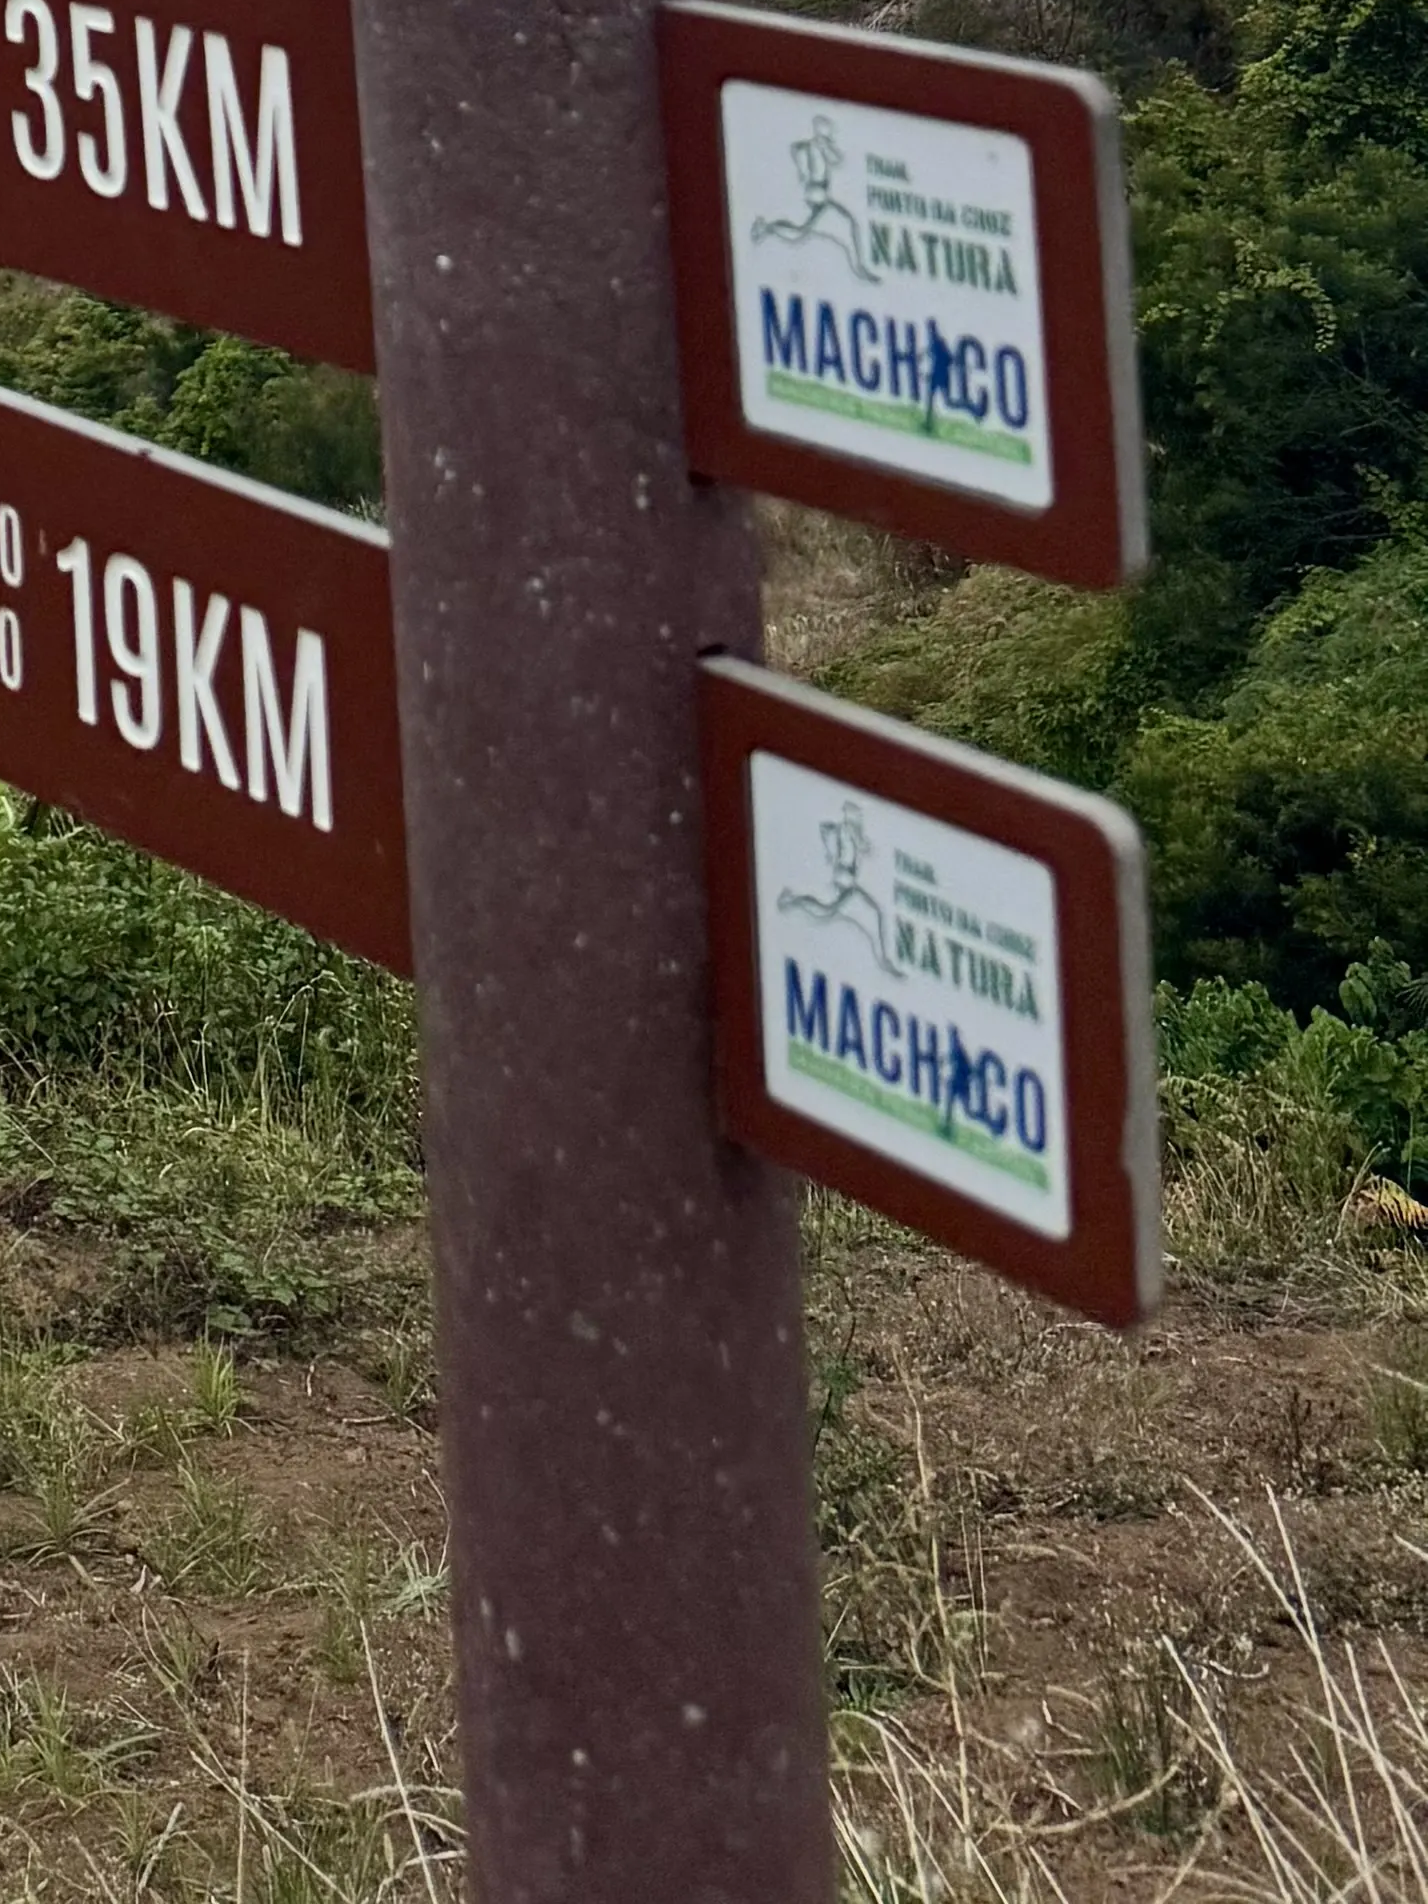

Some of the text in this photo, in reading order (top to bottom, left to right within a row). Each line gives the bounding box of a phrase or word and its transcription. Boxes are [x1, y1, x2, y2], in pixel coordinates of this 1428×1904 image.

[869, 220, 1018, 296] NATURA
[960, 205, 1012, 237] CRUZ
[760, 287, 1029, 431] MACHICO
[56, 537, 333, 833] 19KM
[896, 914, 1040, 1022] NATURA
[785, 958, 1045, 1152] MACHICO
